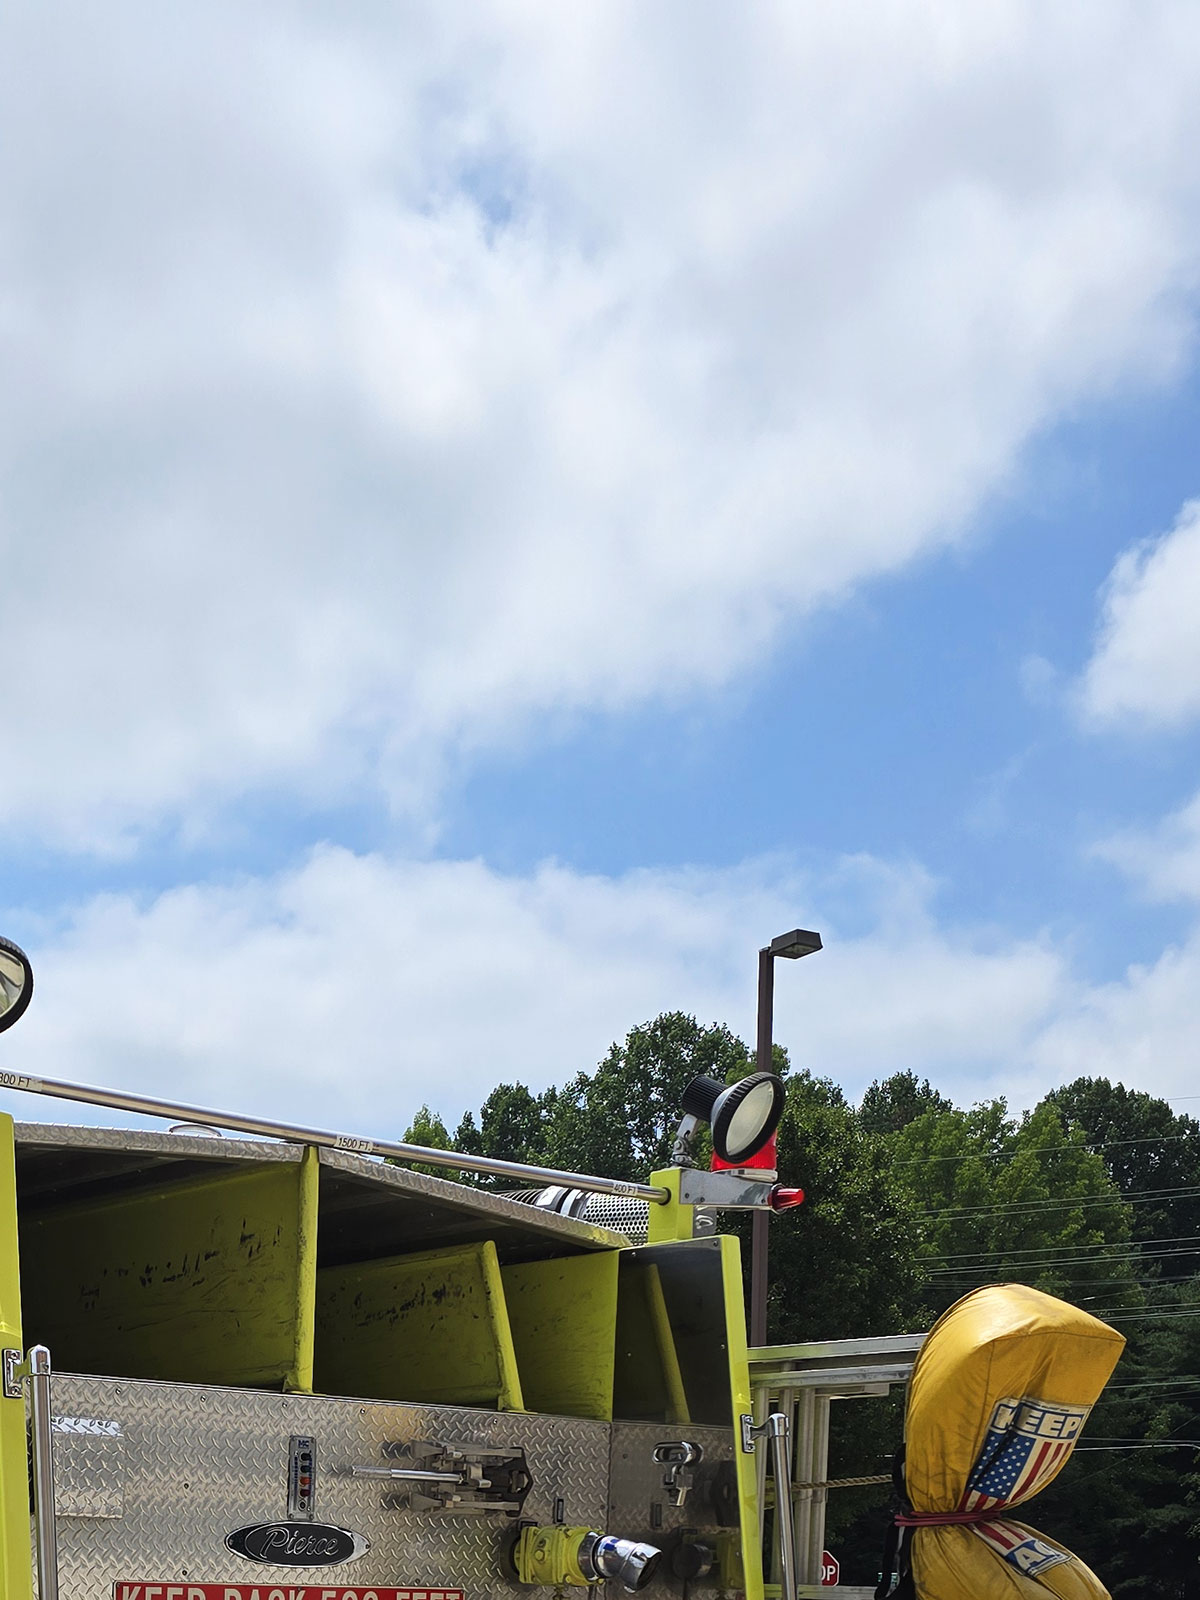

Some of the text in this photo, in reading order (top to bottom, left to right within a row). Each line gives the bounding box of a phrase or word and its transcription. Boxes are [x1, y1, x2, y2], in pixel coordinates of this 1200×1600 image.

[17, 1076, 32, 1088] FT
[338, 1137, 357, 1149] 1500
[613, 1184, 627, 1194] 400
[260, 1526, 339, 1559] Pierce
